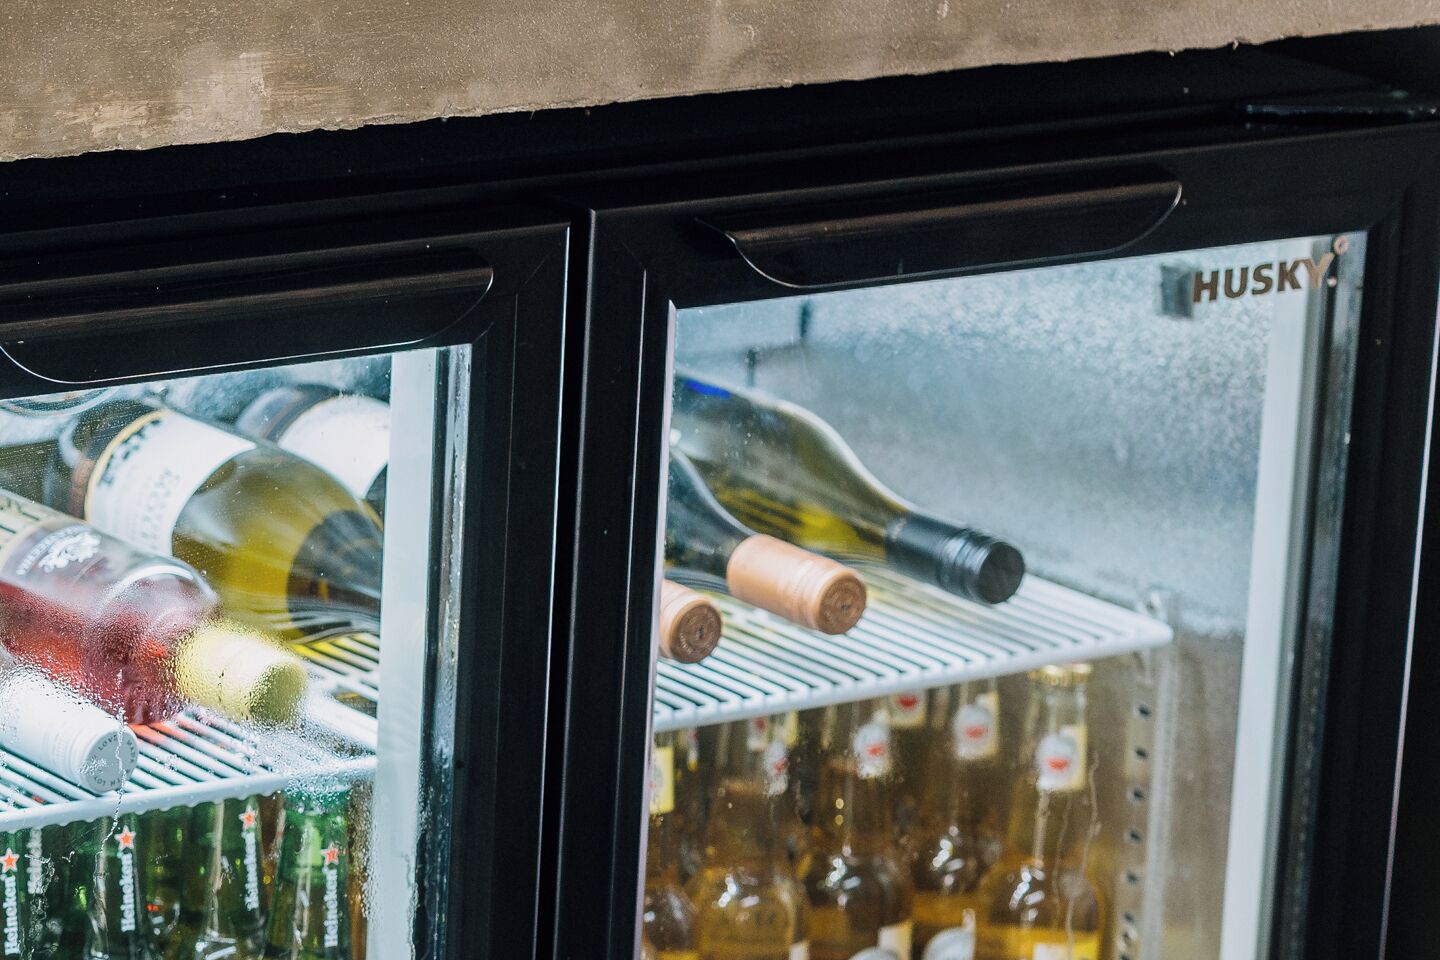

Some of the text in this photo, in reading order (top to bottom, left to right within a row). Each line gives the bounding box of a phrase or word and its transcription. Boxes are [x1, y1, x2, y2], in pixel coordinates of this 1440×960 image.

[1193, 252, 1335, 303] HUSKY
[4, 876, 19, 955] Heineken
[120, 853, 136, 932] Heineken
[323, 868, 340, 948] Heineken
